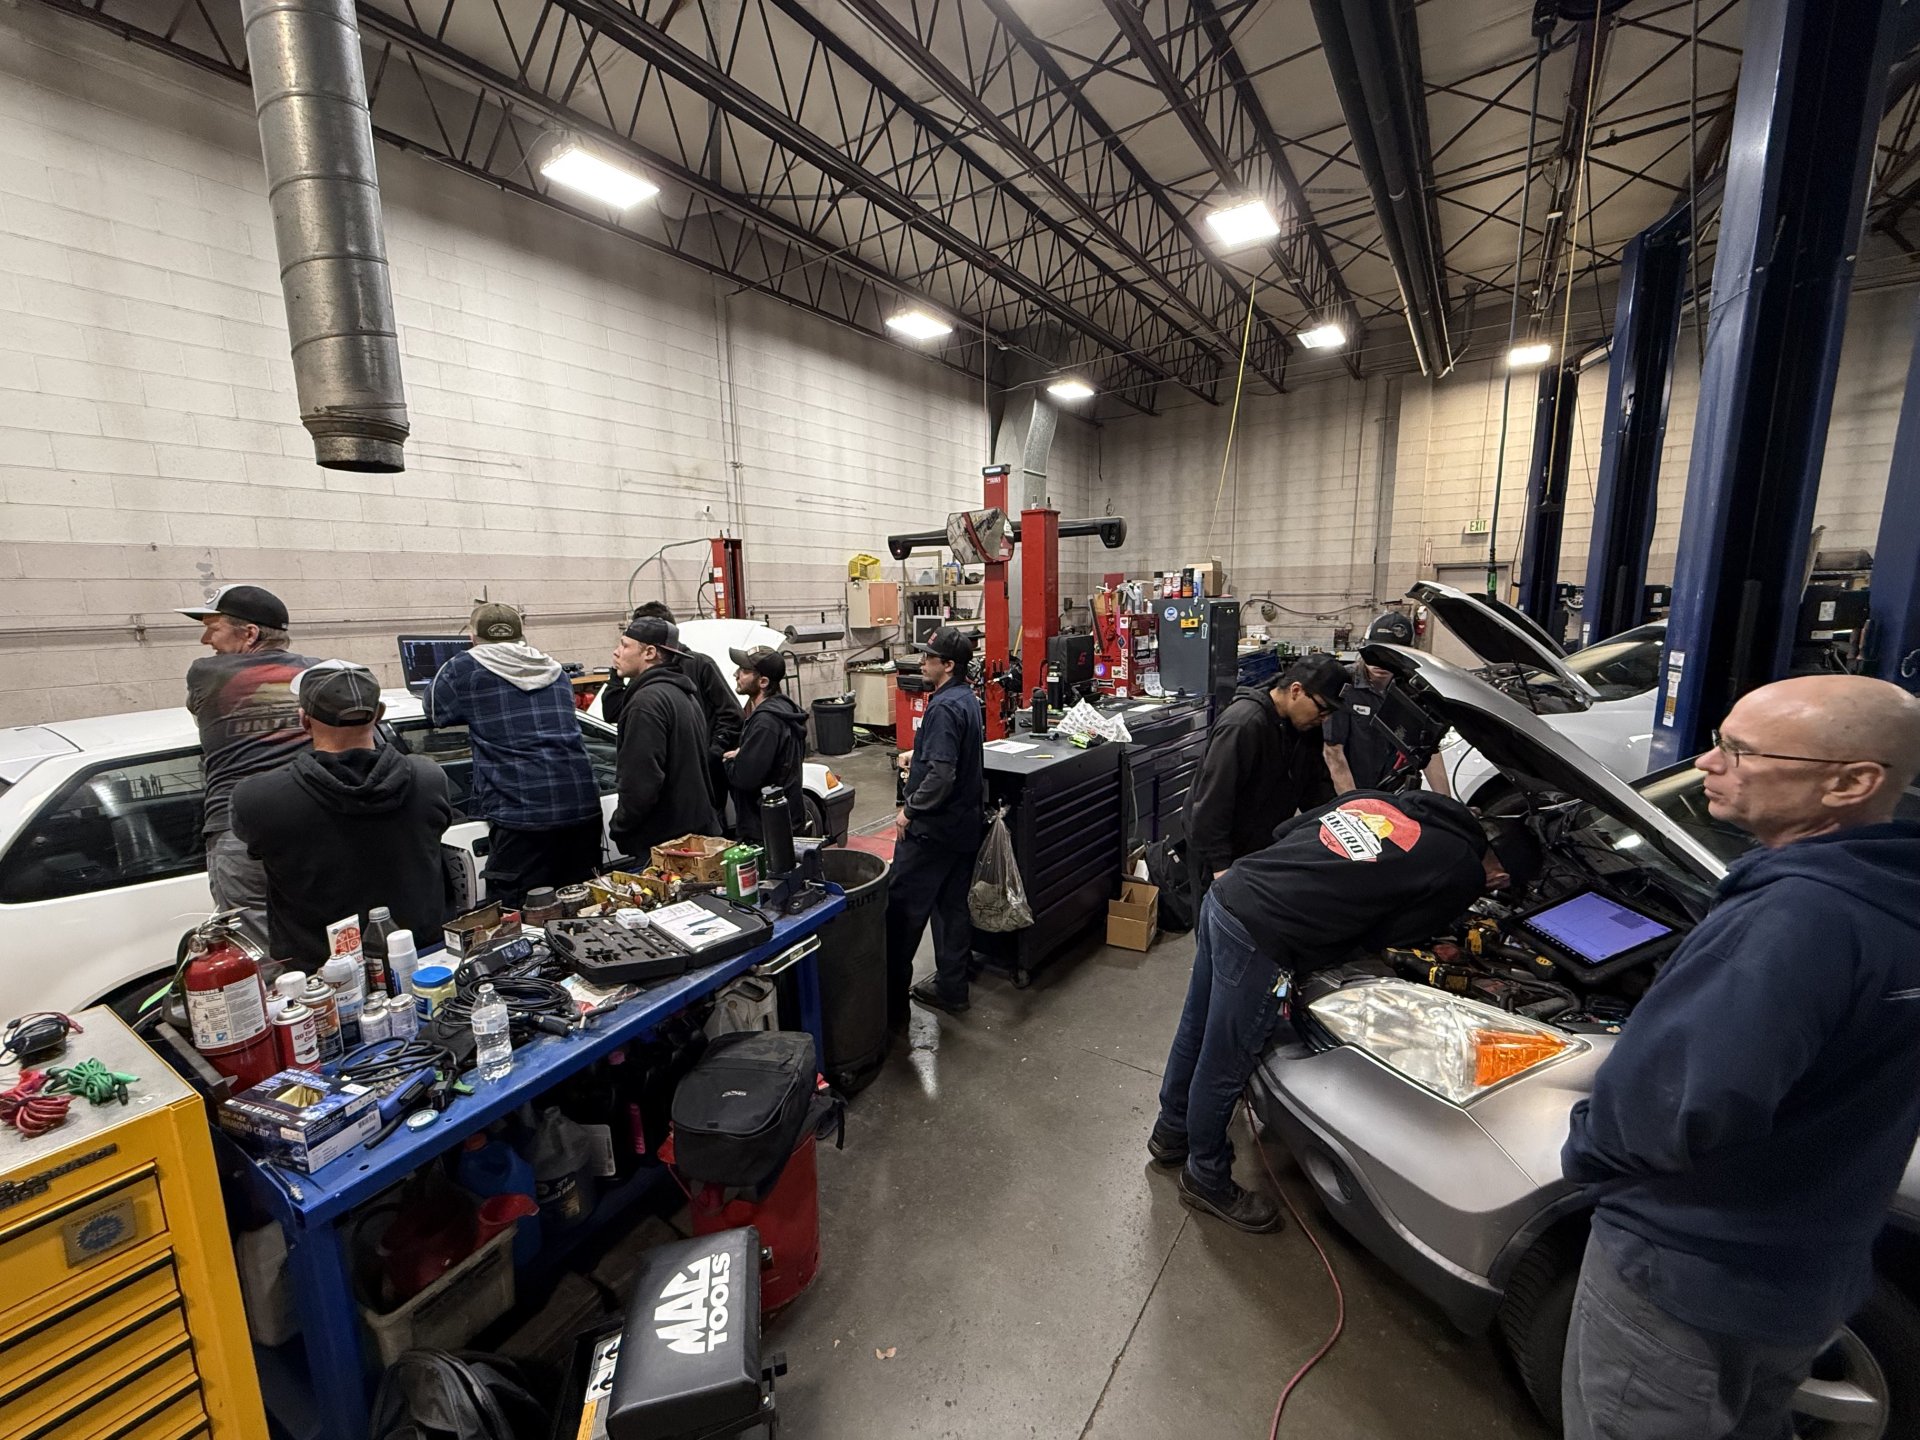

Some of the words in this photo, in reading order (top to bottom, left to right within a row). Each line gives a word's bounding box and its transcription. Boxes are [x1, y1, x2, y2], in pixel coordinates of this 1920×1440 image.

[1469, 520, 1487, 531] EXIT
[1326, 814, 1365, 854] ANTERO
[847, 890, 880, 910] RUTE
[654, 1255, 711, 1354] MAC
[707, 1251, 731, 1352] TOOLS
